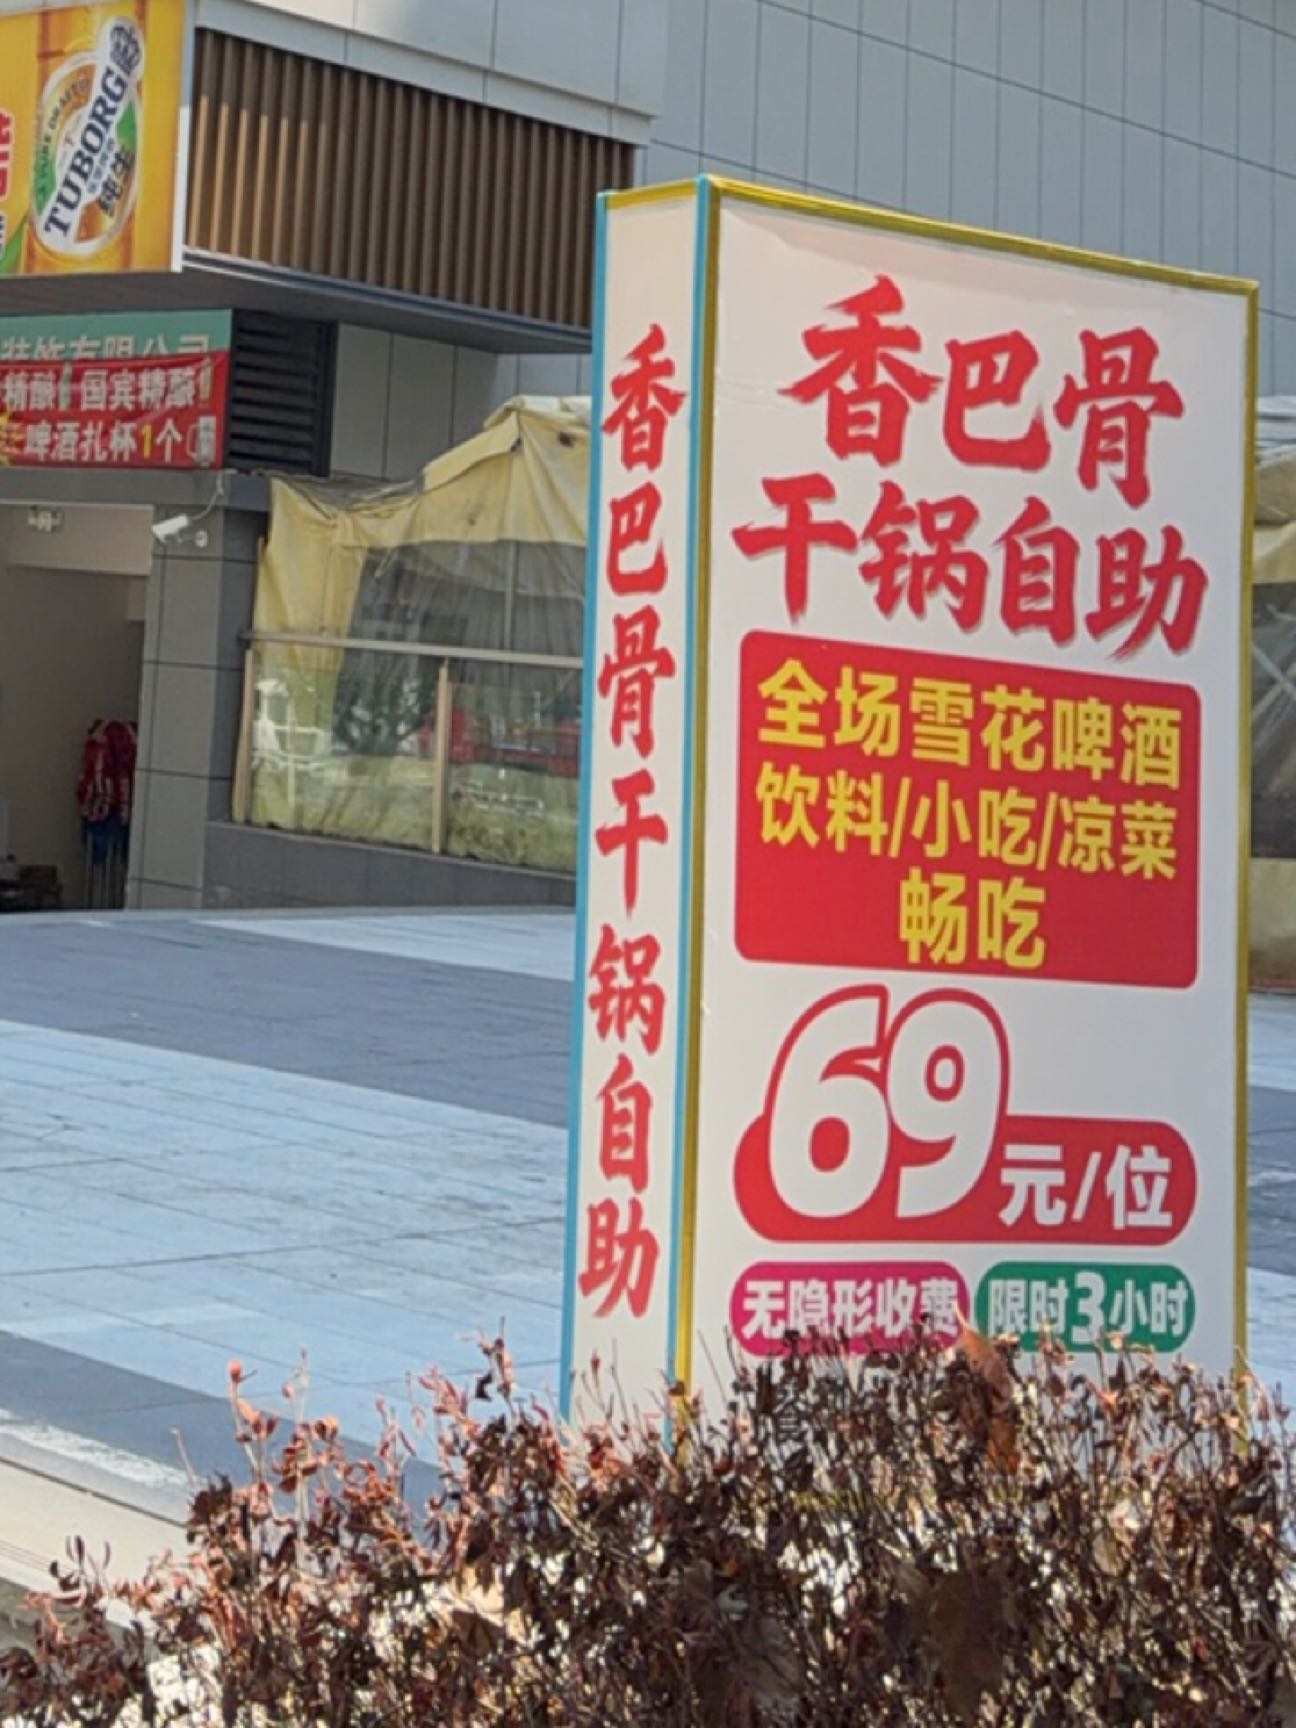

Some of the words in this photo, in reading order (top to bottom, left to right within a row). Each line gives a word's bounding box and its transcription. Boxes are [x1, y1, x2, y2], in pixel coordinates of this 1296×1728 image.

[44, 68, 129, 239] TUBORG
[778, 274, 1186, 509] 香巴骨
[731, 473, 1210, 660] 干锅自助
[756, 657, 1183, 792] 全场雪花啤酒
[577, 322, 687, 1319] 香巴骨干锅自助
[754, 762, 1178, 882] 饮料/小吃/凉菜
[898, 866, 1047, 970] 畅吃
[740, 1276, 959, 1340] 无隐形收费
[988, 1269, 1189, 1345] 限时3小时
